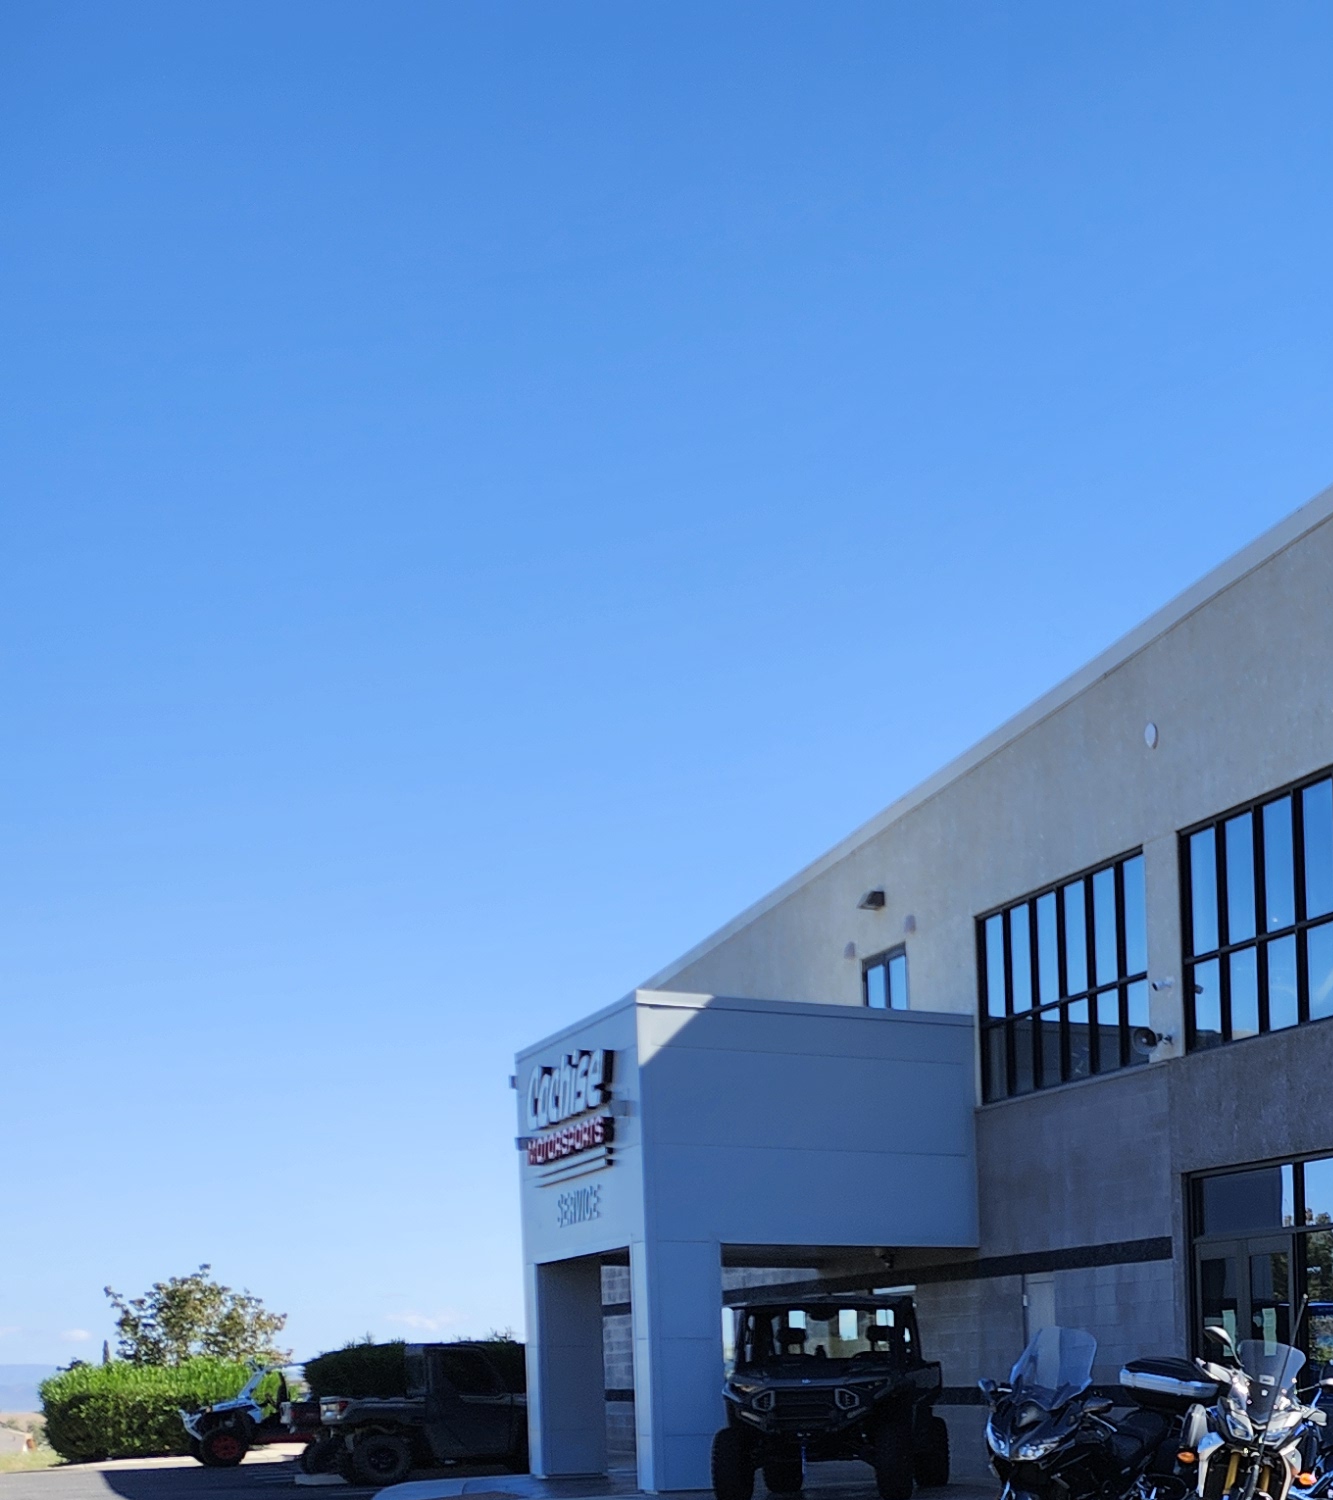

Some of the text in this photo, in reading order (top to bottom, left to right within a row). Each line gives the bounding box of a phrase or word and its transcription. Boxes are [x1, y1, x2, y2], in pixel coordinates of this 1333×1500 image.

[526, 1049, 606, 1130] Cochise
[527, 1116, 606, 1166] MOTORSPORTS
[557, 1185, 603, 1228] SERVICE
